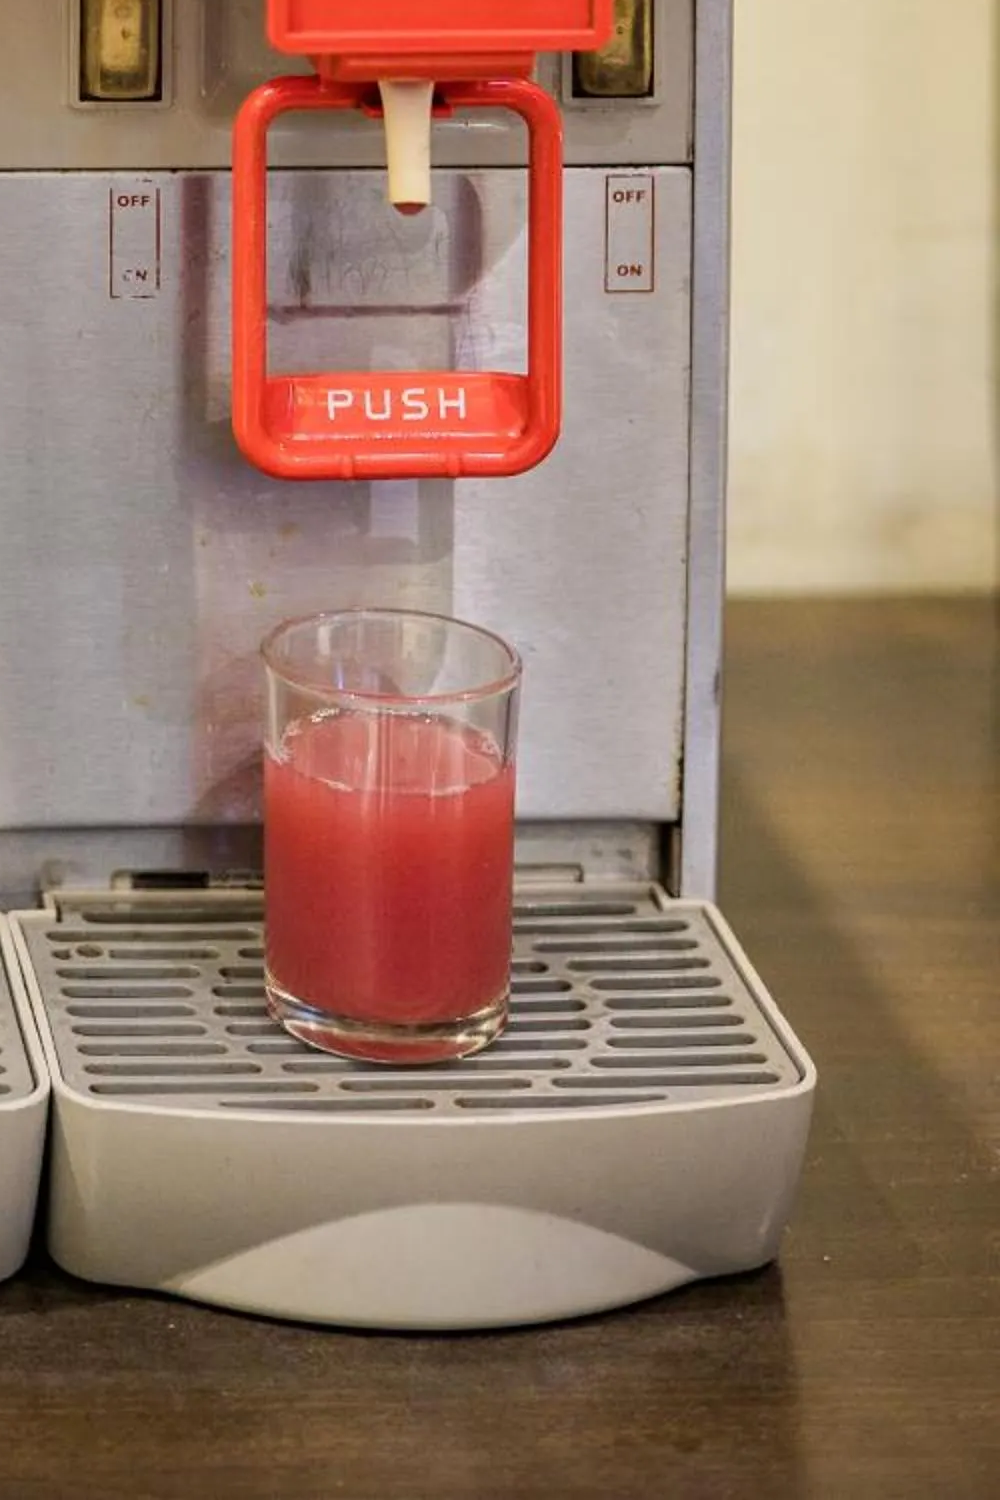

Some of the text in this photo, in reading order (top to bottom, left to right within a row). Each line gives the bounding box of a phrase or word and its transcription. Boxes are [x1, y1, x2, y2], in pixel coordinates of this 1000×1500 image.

[117, 195, 151, 207] OFF
[612, 190, 646, 203] OFF
[616, 264, 642, 277] ON
[327, 387, 467, 421] PUSH
